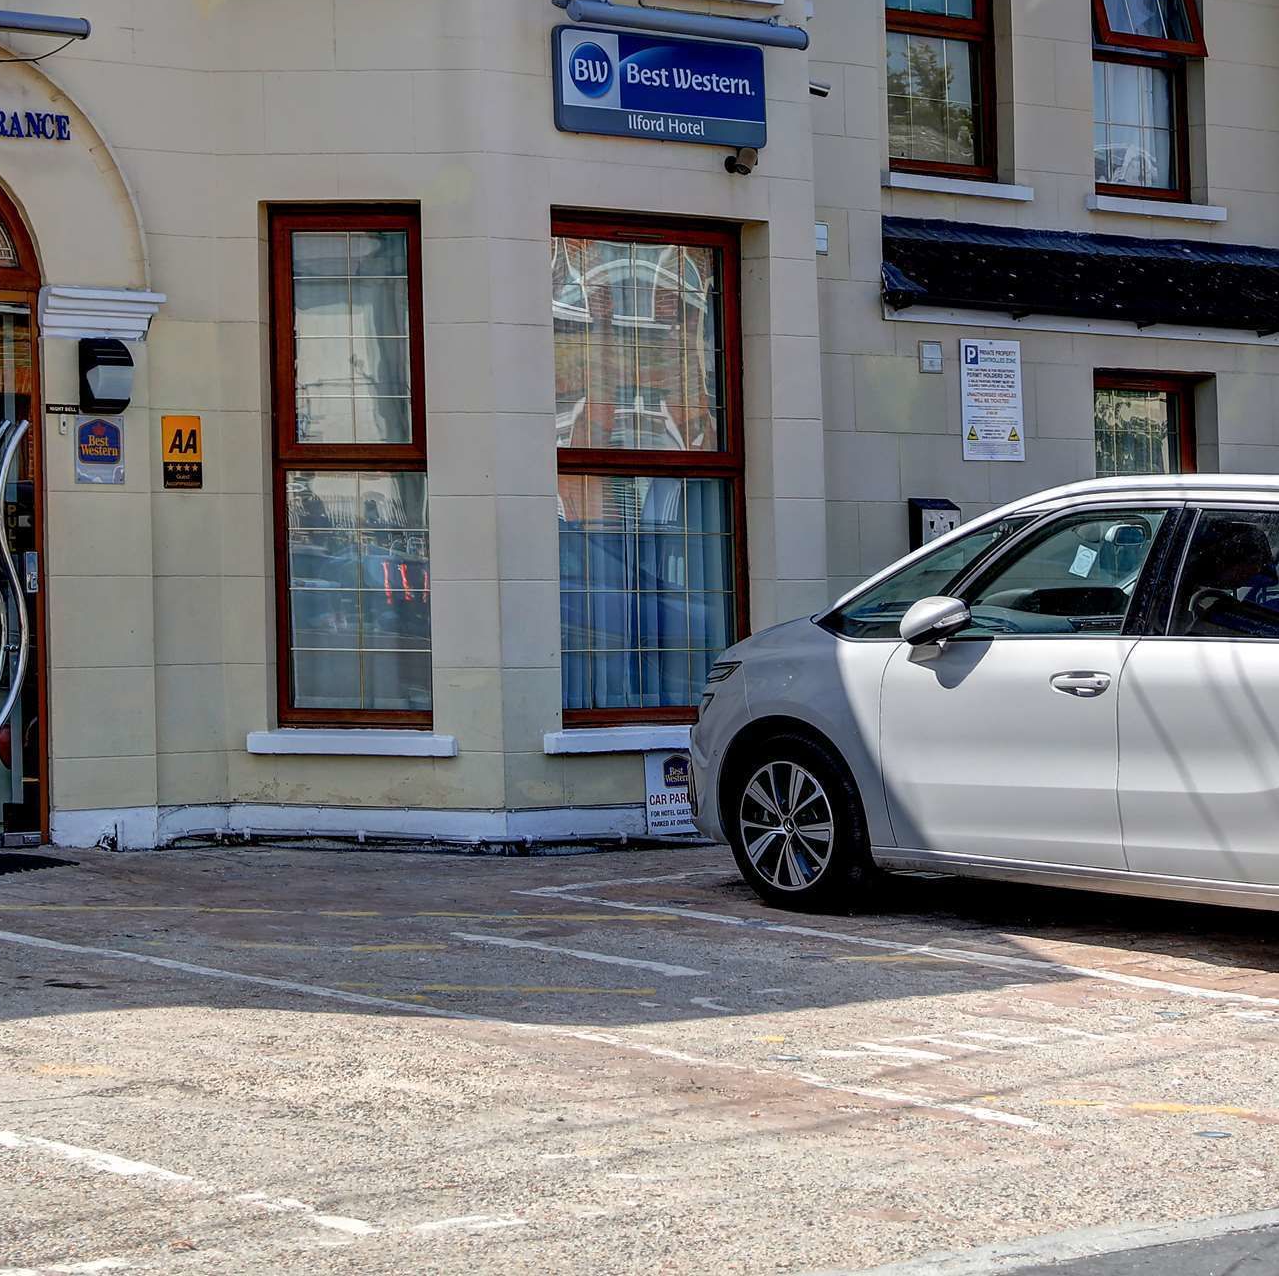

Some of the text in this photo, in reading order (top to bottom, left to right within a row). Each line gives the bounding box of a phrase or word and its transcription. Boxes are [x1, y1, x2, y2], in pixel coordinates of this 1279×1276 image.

[574, 58, 608, 83] BW
[626, 62, 669, 88] Best
[628, 114, 705, 136] Ilford Hotel
[967, 347, 976, 362] P
[80, 444, 118, 456] Western
[88, 435, 109, 447] Best
[168, 429, 197, 454] AA
[8, 505, 17, 551] PULL
[650, 794, 667, 805] CAR
